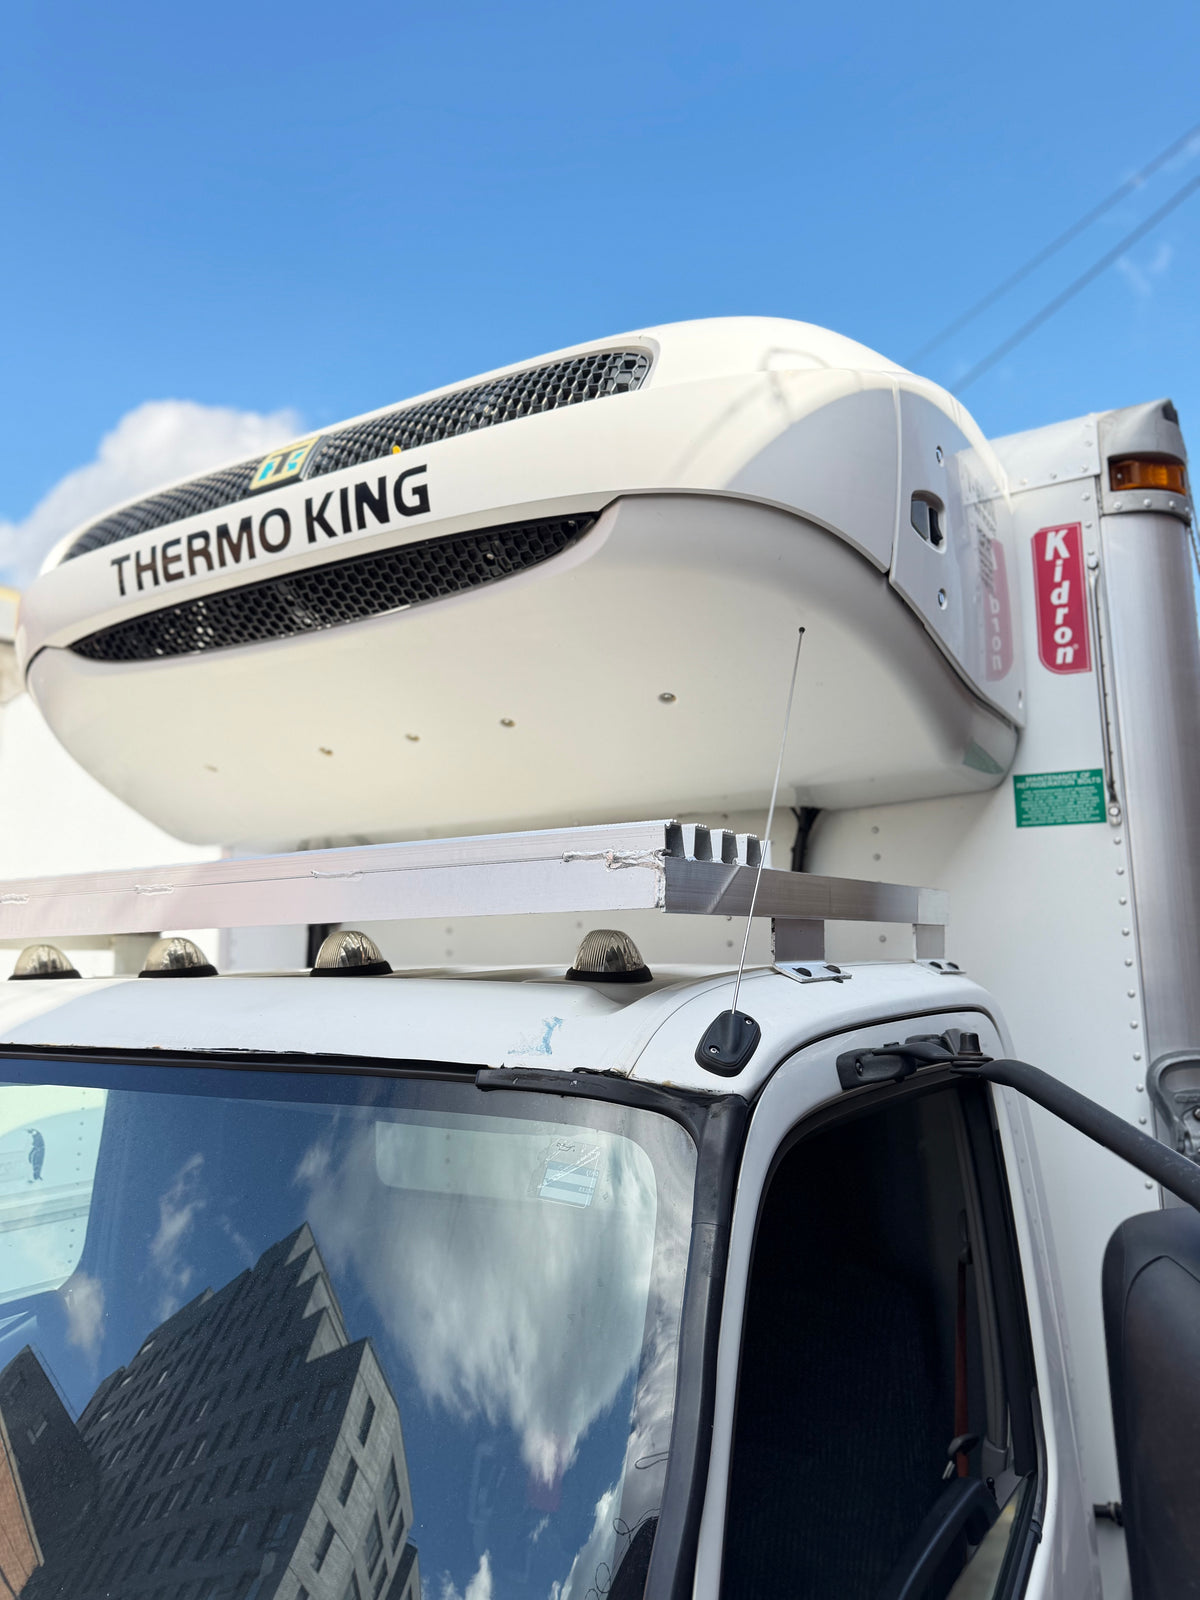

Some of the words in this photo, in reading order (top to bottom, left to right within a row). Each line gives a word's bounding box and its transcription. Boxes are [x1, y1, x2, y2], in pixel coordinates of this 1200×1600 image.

[111, 508, 292, 596] THERMO
[305, 464, 430, 543] KING
[1045, 529, 1075, 665] Kidron
[1016, 780, 1075, 789] REFRIGERATION
[1077, 776, 1101, 785] BOLTS
[1025, 772, 1077, 782] MAINTENANCE
